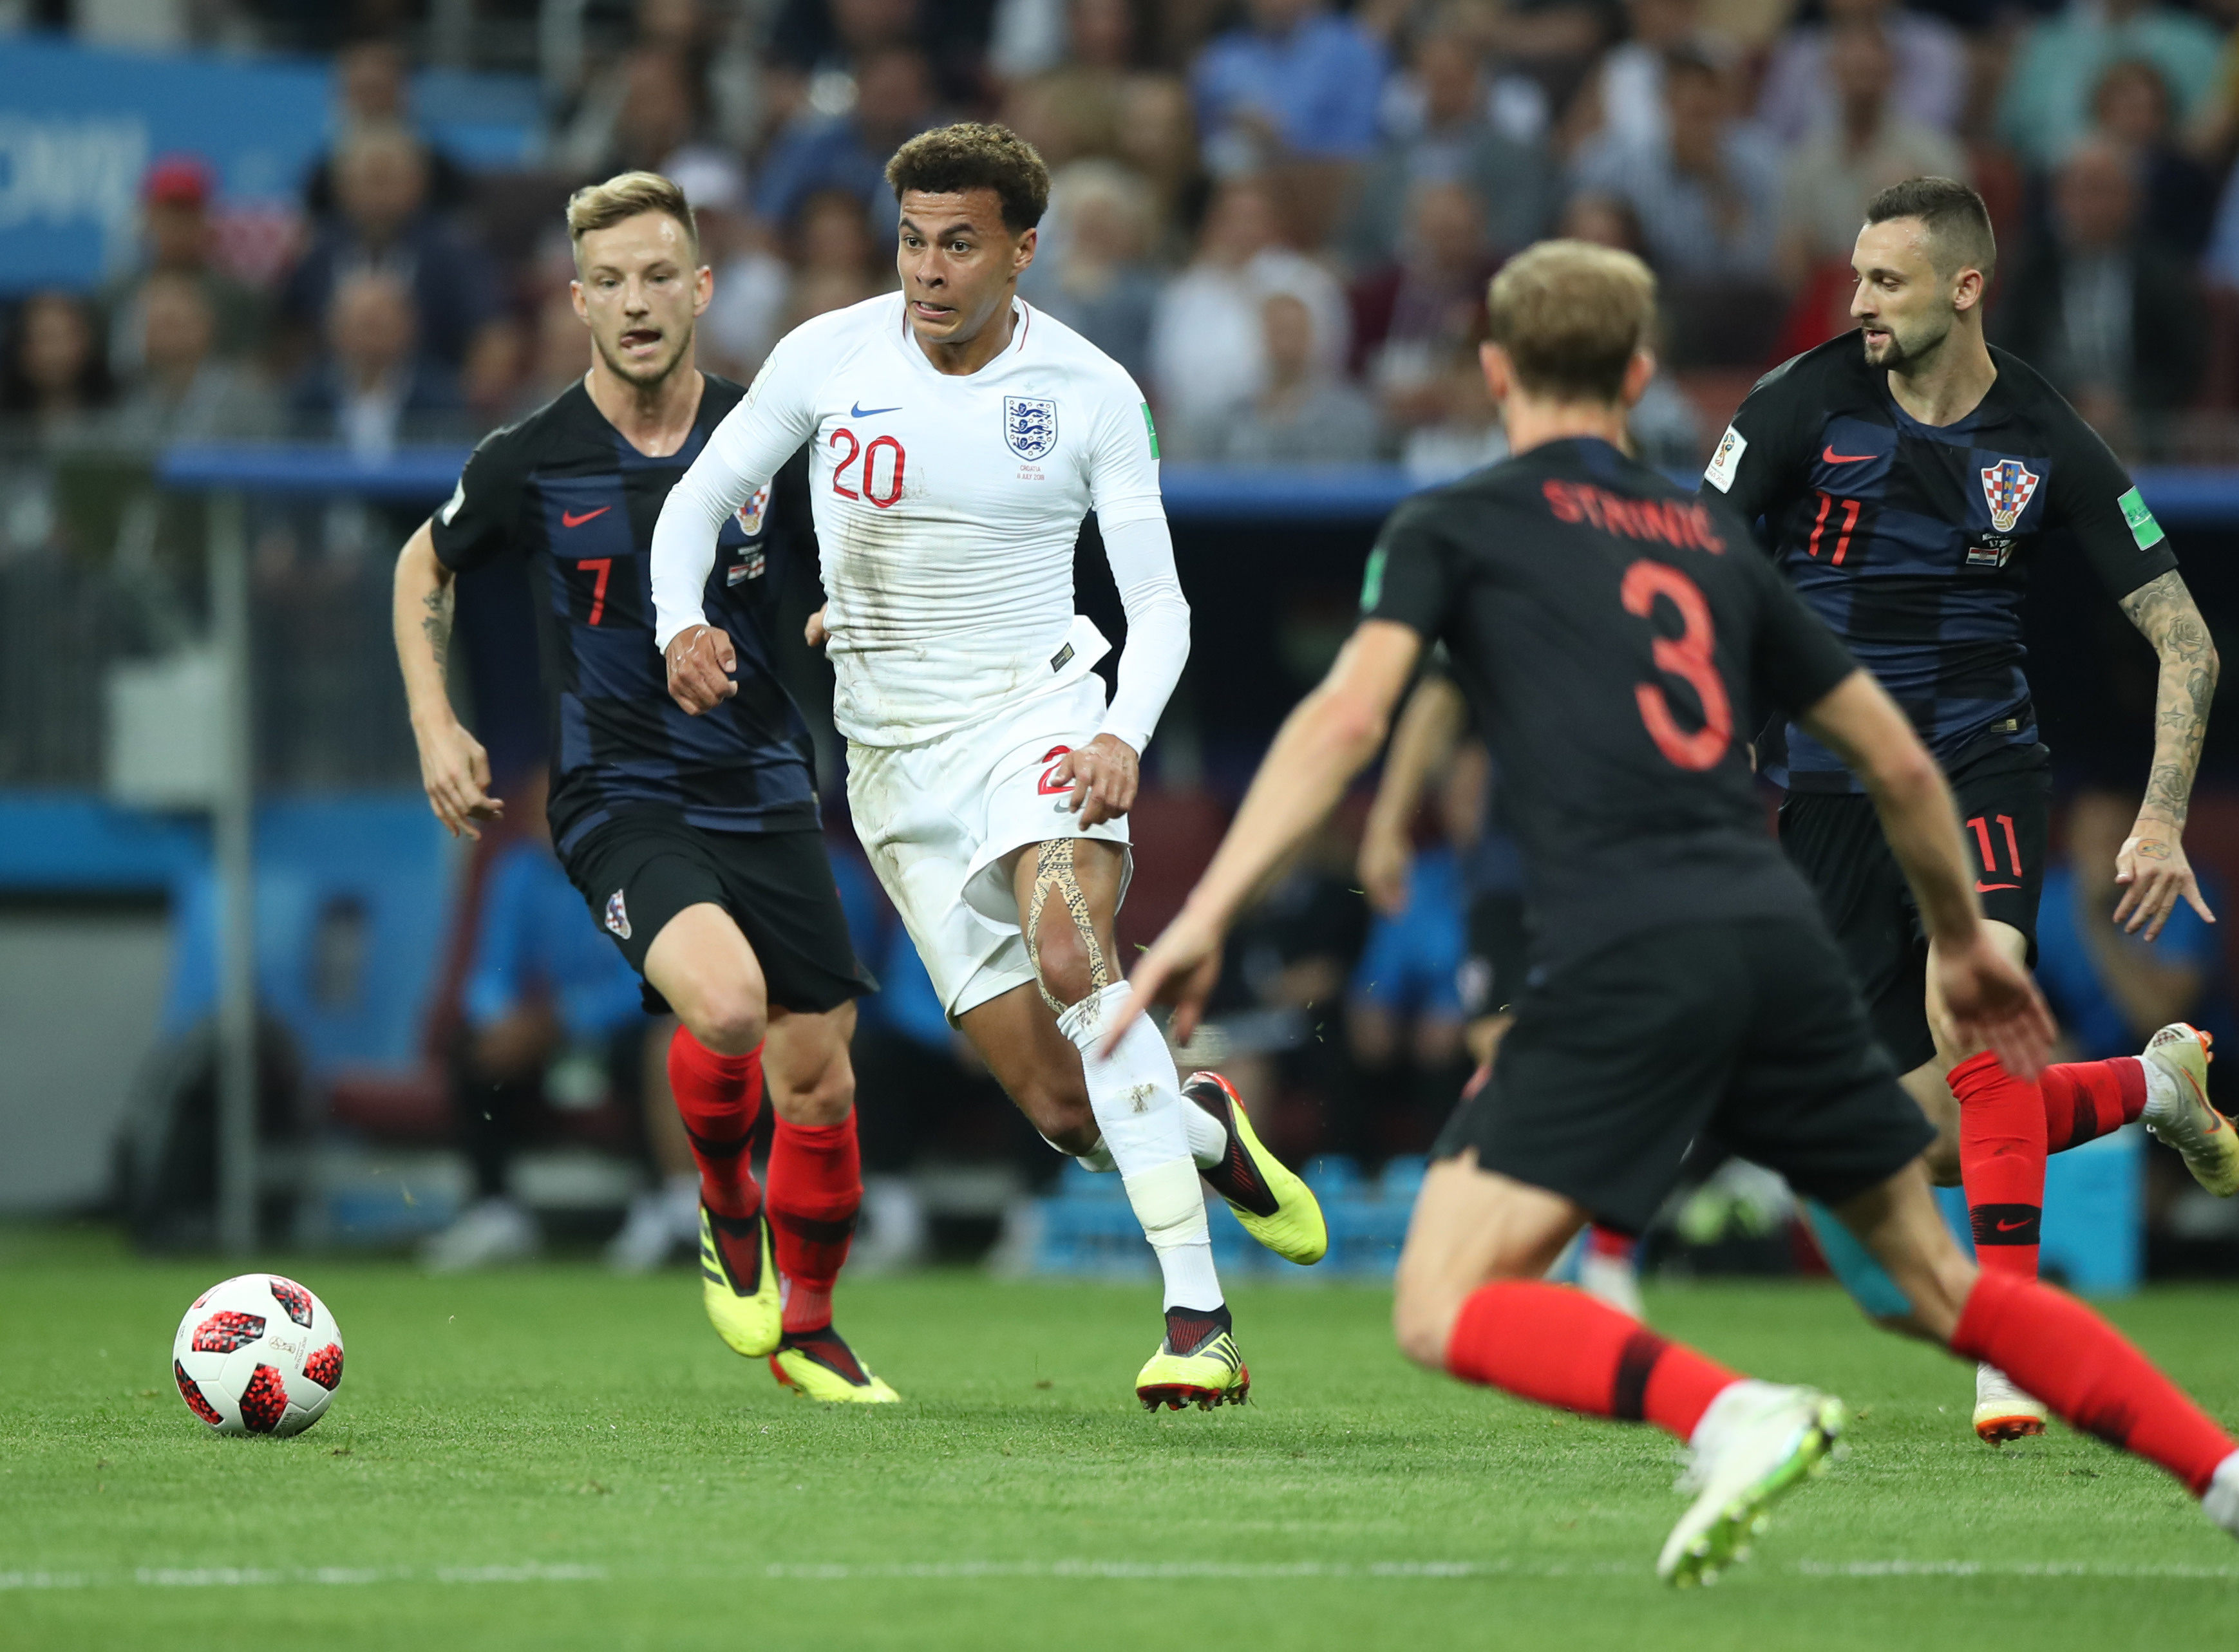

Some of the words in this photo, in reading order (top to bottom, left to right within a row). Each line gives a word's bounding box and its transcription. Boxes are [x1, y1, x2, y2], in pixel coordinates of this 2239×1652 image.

[829, 427, 906, 509] 20
[1808, 490, 1861, 565] 11
[577, 558, 612, 626] 7
[1620, 558, 1734, 770] 3
[1038, 745, 1076, 796] 2
[1966, 814, 2023, 878] 11
